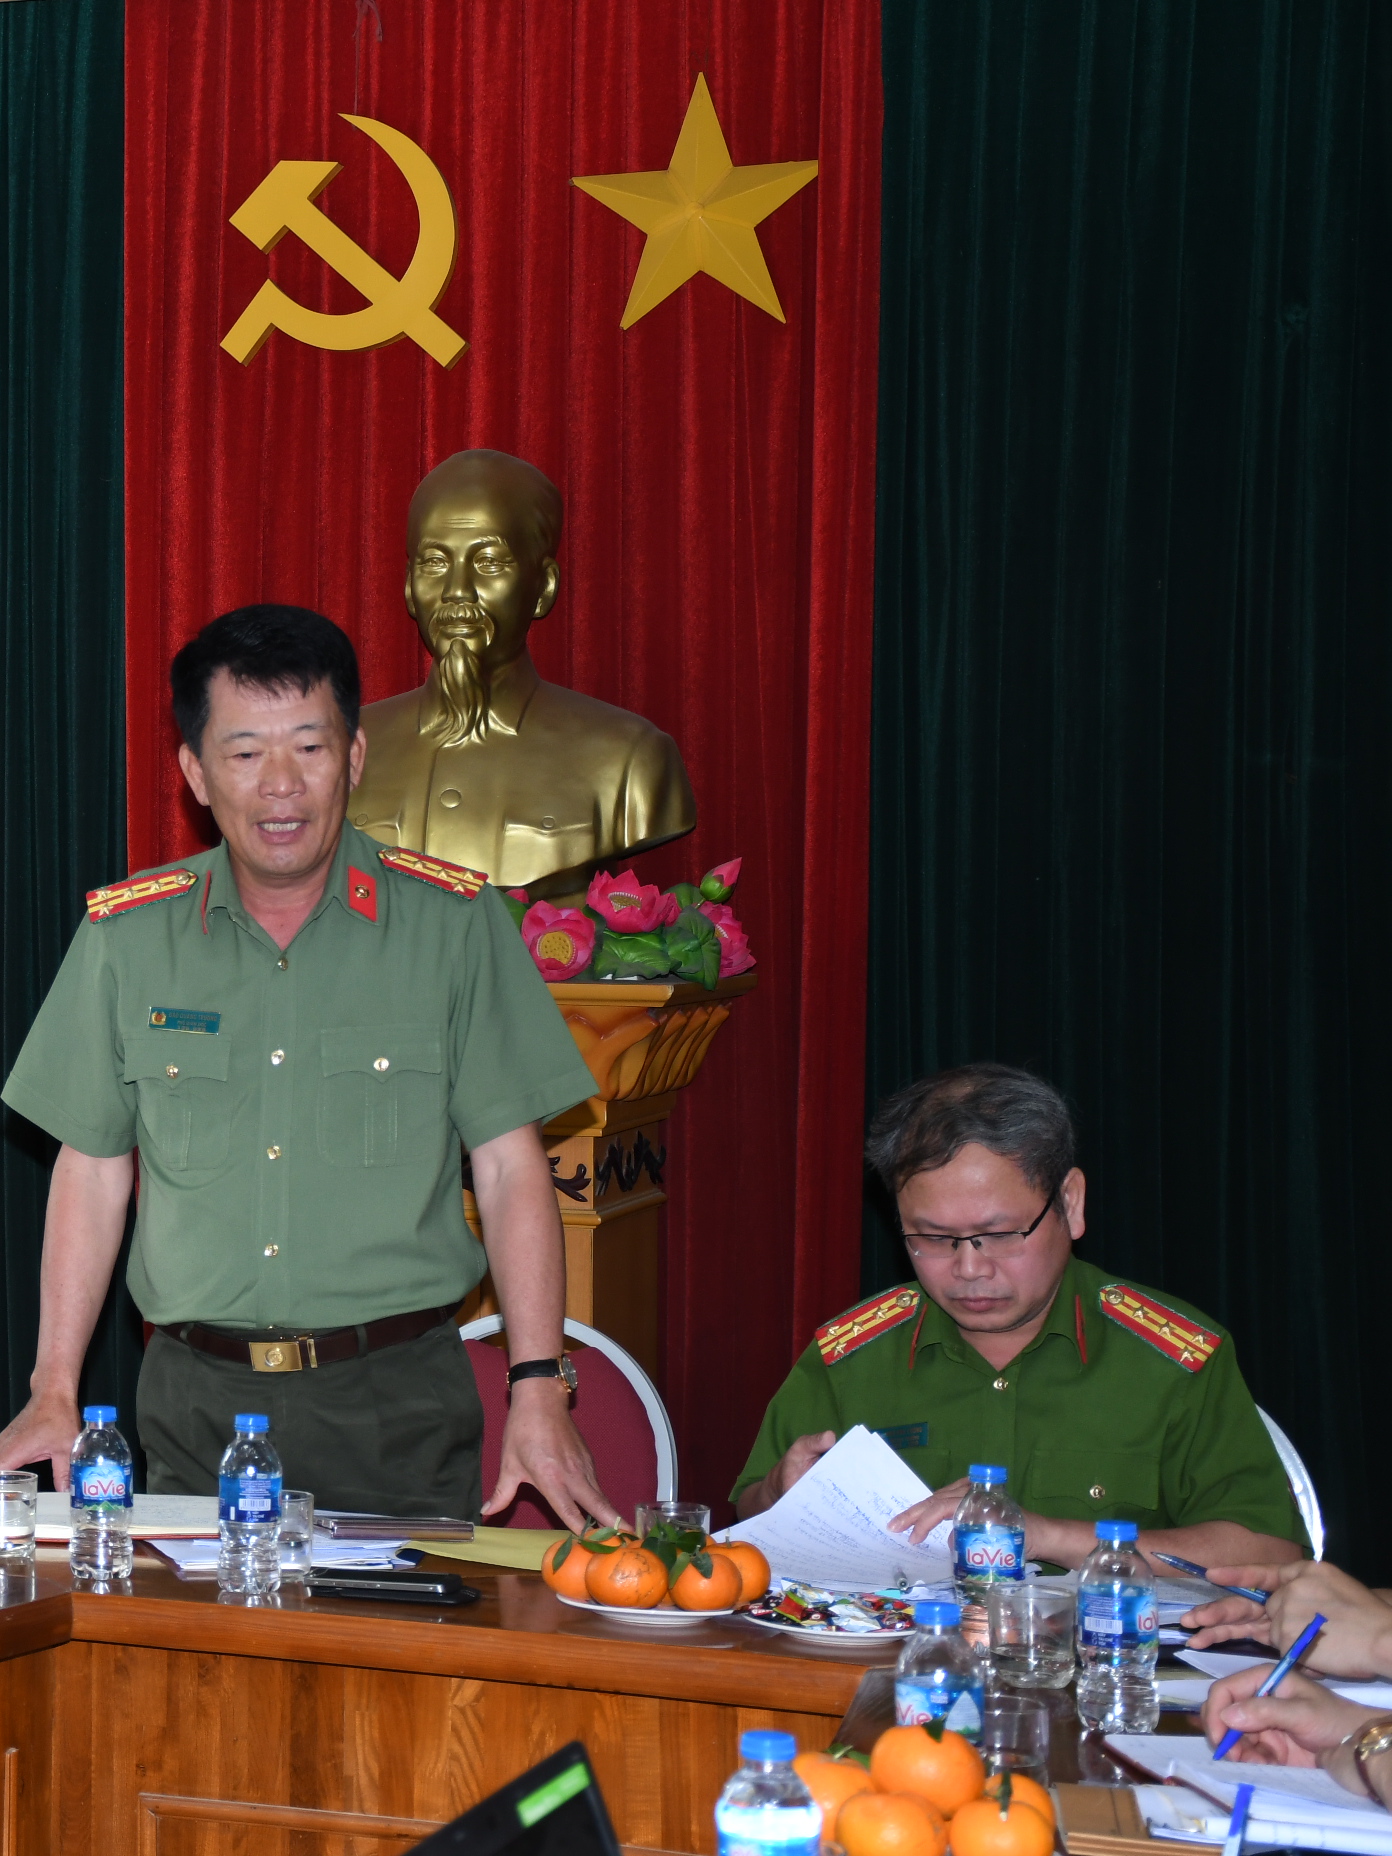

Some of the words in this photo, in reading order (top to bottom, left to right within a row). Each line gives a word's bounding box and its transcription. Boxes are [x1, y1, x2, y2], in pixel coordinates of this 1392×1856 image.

[83, 1479, 125, 1496] laVie
[967, 1547, 1015, 1566] laVie
[895, 1699, 932, 1725] Vie
